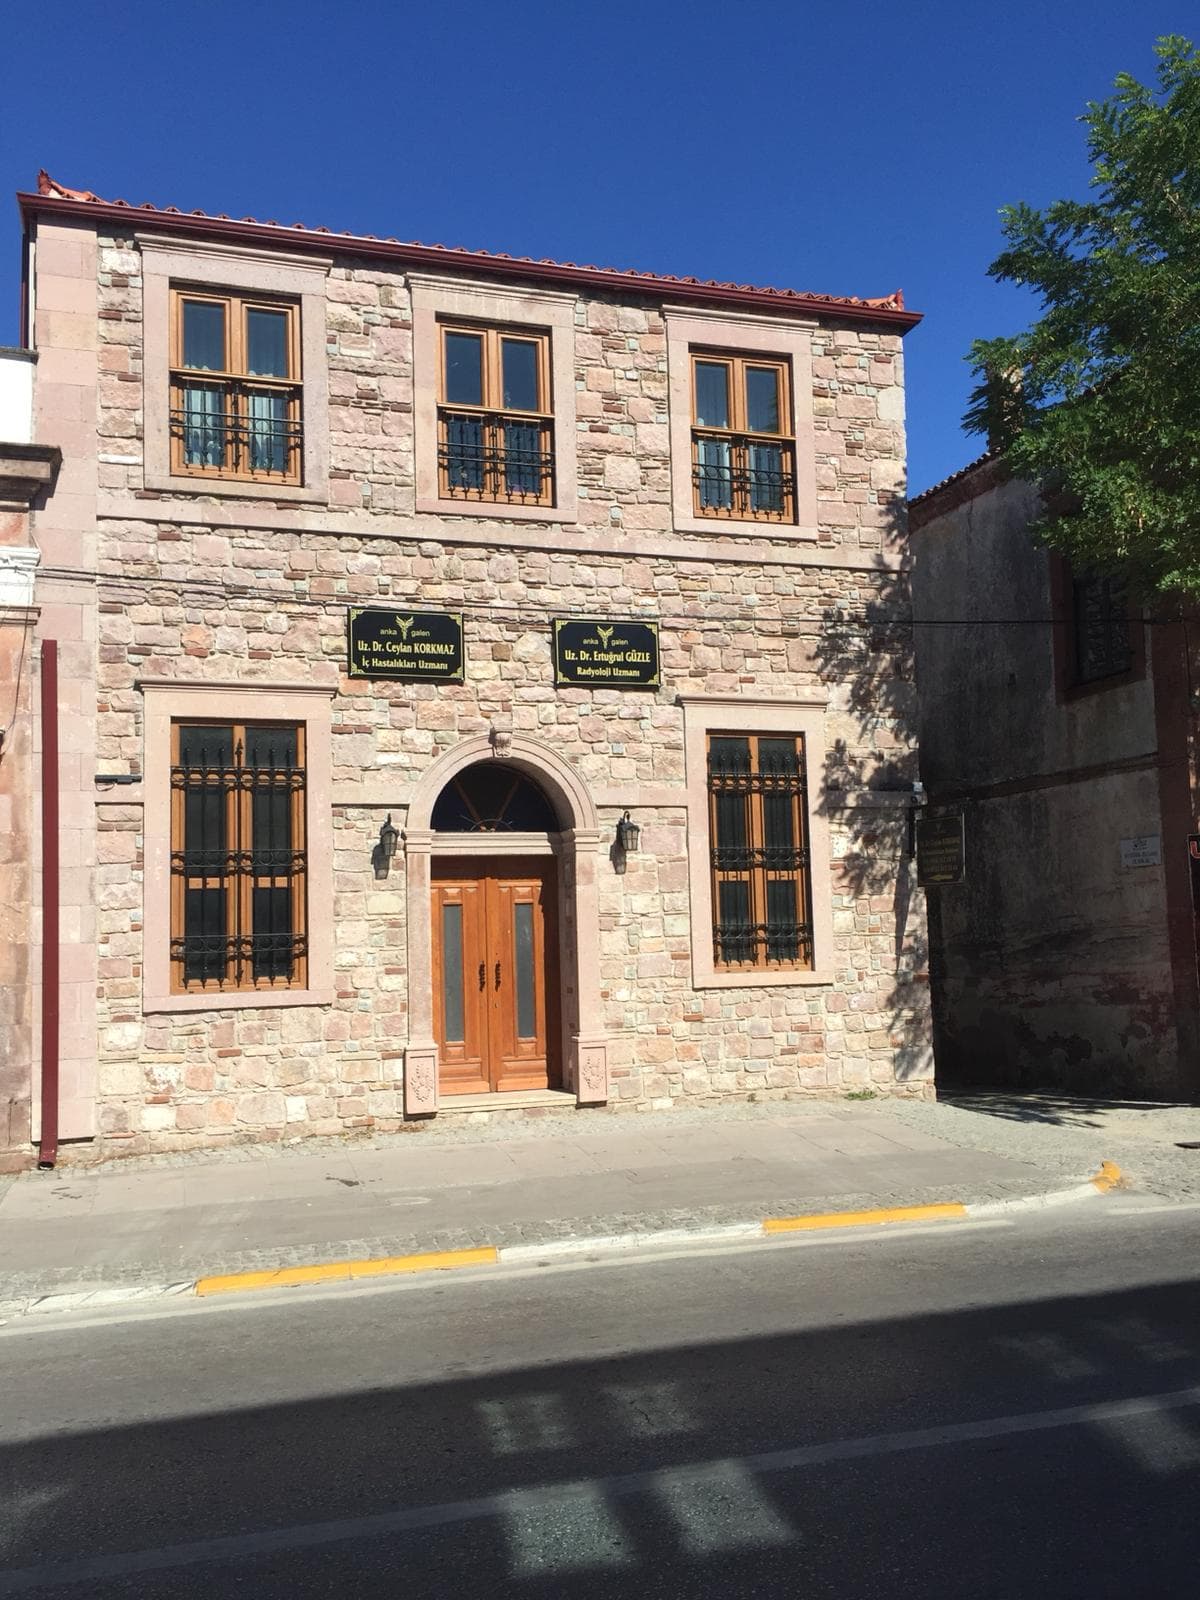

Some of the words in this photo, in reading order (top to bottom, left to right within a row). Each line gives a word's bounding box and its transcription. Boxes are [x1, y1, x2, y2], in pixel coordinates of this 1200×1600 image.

[358, 640, 371, 651] Uz.
[373, 641, 384, 652] Dr.
[386, 642, 412, 655] Ceylan
[414, 643, 455, 655] KORKMAZ
[565, 650, 578, 660] Uz.
[580, 651, 592, 661] Dr.
[594, 651, 624, 664] Ertuğrul
[419, 660, 448, 670] Uzmanı
[577, 667, 611, 677] Radyoloji
[613, 668, 640, 677] Uzmanı
